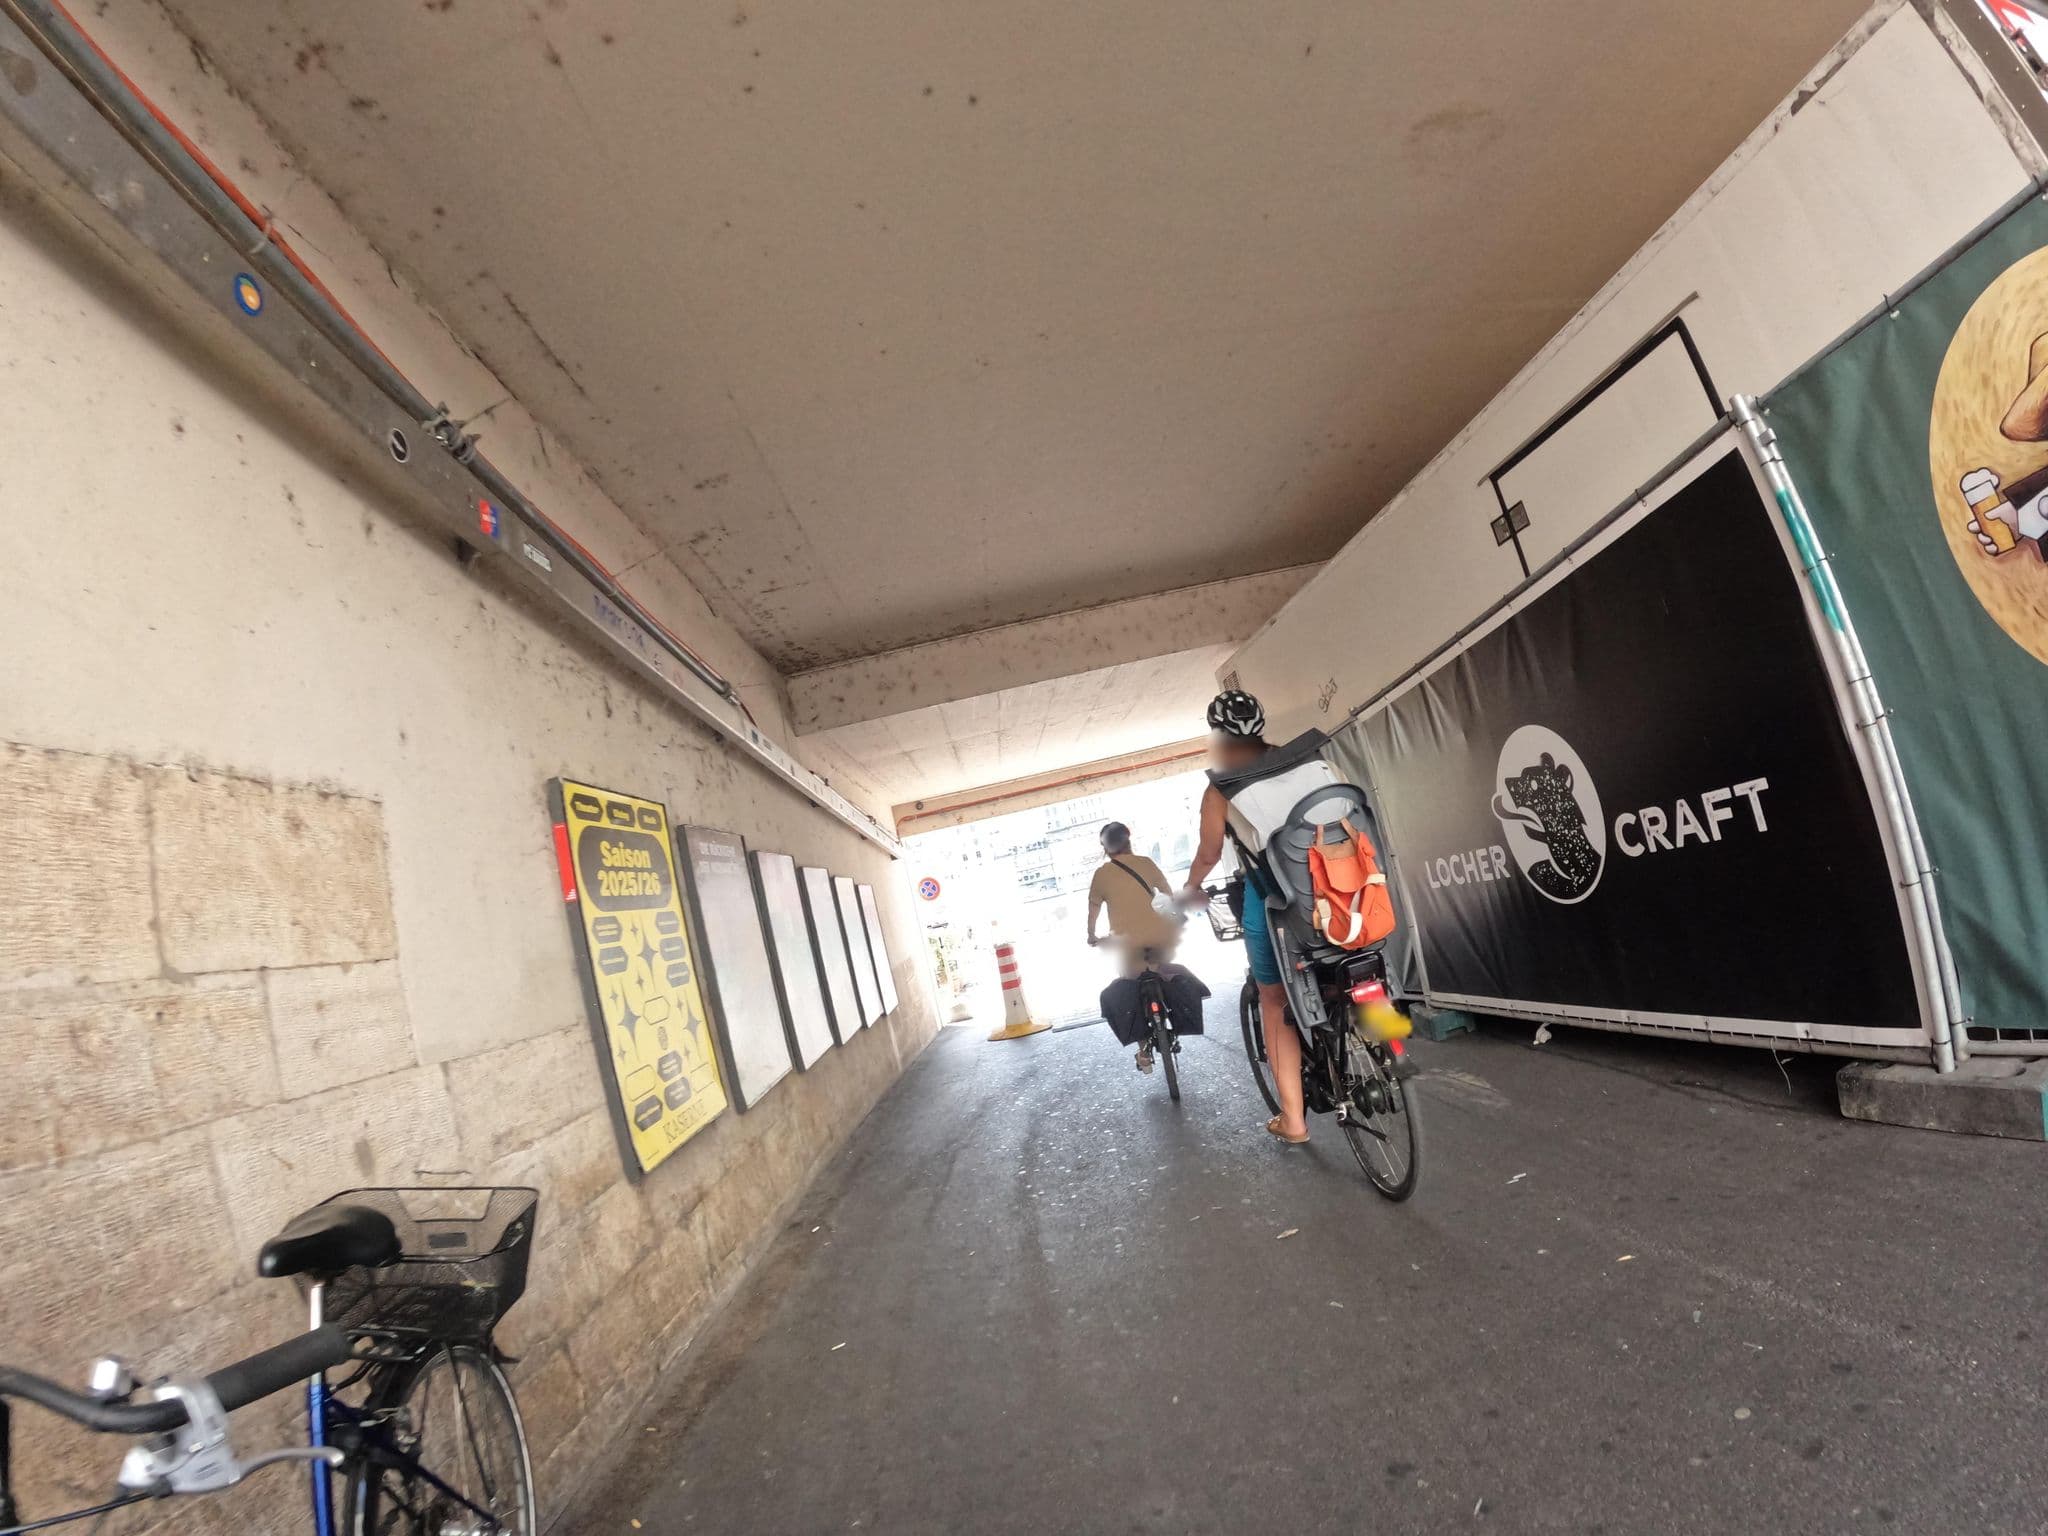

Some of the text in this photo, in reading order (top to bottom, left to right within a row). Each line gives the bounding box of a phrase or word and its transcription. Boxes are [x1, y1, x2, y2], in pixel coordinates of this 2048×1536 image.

[1425, 777, 1769, 888] LOCHER CRAFT
[600, 841, 651, 868] Saison
[597, 870, 661, 896] 2025/26
